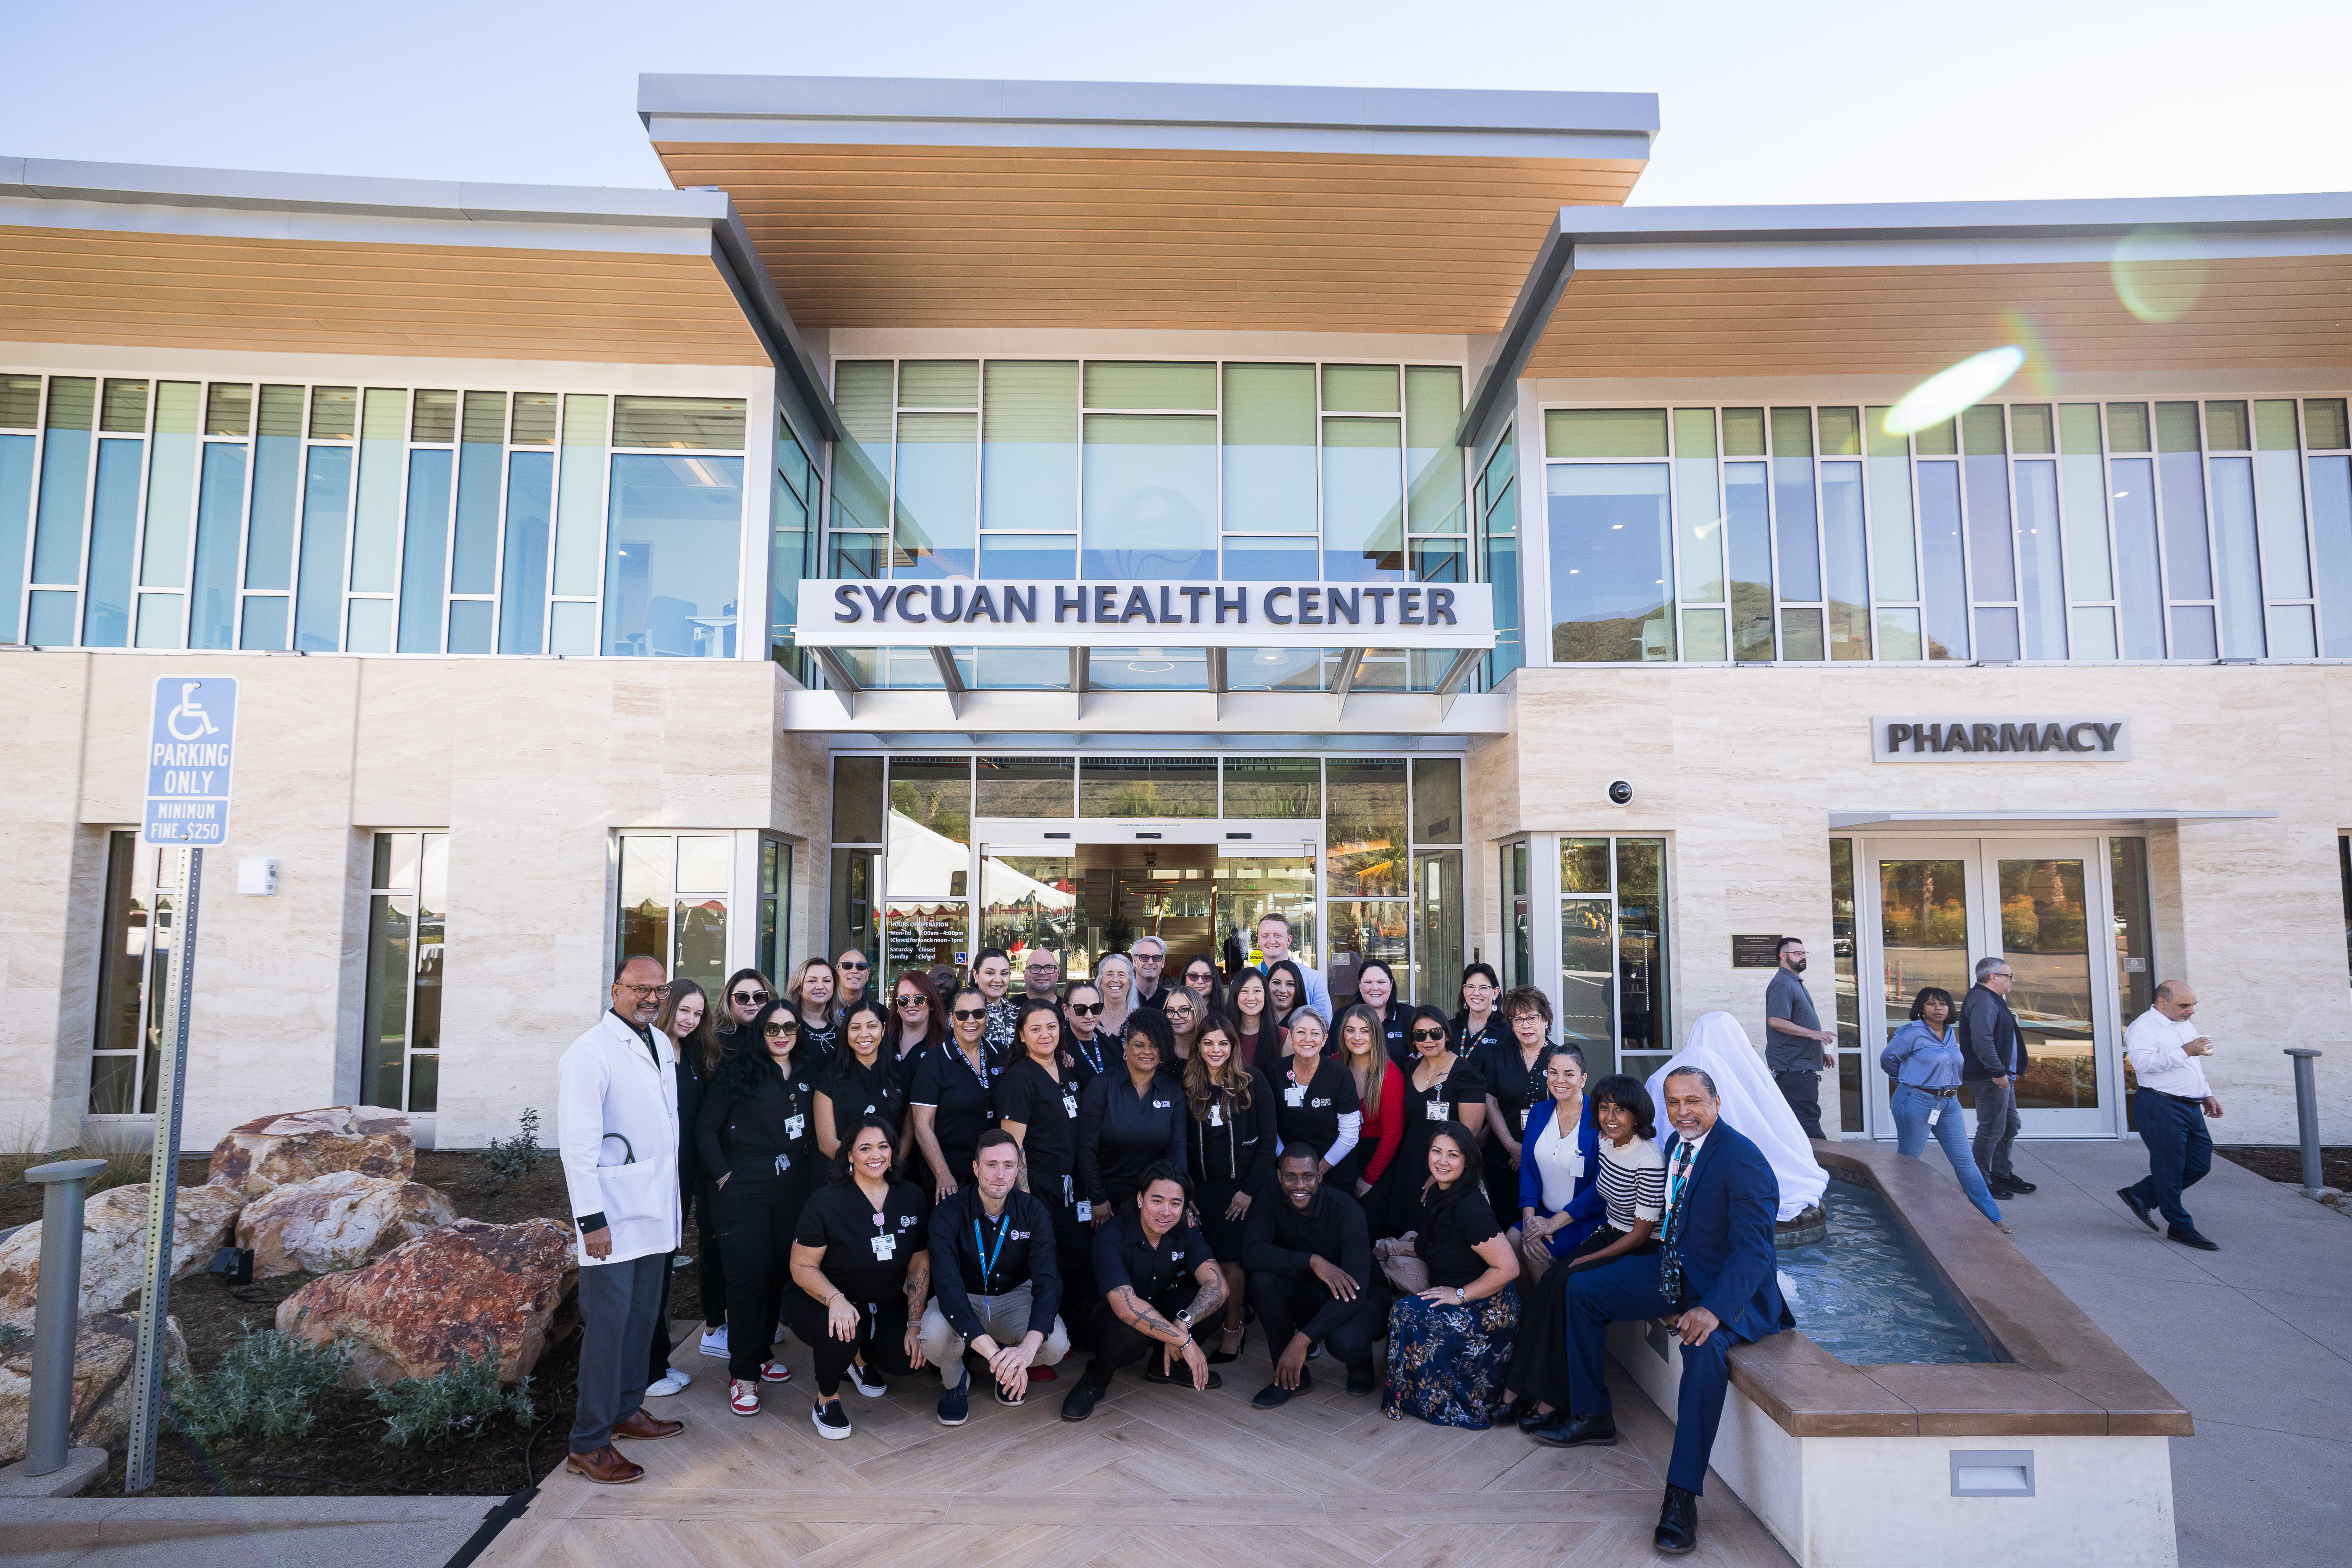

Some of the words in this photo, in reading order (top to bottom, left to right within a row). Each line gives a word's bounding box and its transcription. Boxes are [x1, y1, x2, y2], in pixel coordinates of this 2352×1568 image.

[834, 584, 1036, 623] SYCUAN
[1054, 585, 1248, 624] HEALTH
[1263, 586, 1457, 625] CENTER
[1888, 722, 2123, 753] PHARMACY
[153, 743, 229, 767] PARKING
[164, 770, 214, 794] ONLY
[158, 803, 215, 819] MINIMUM
[150, 823, 179, 839] FINE
[187, 822, 219, 840] $250
